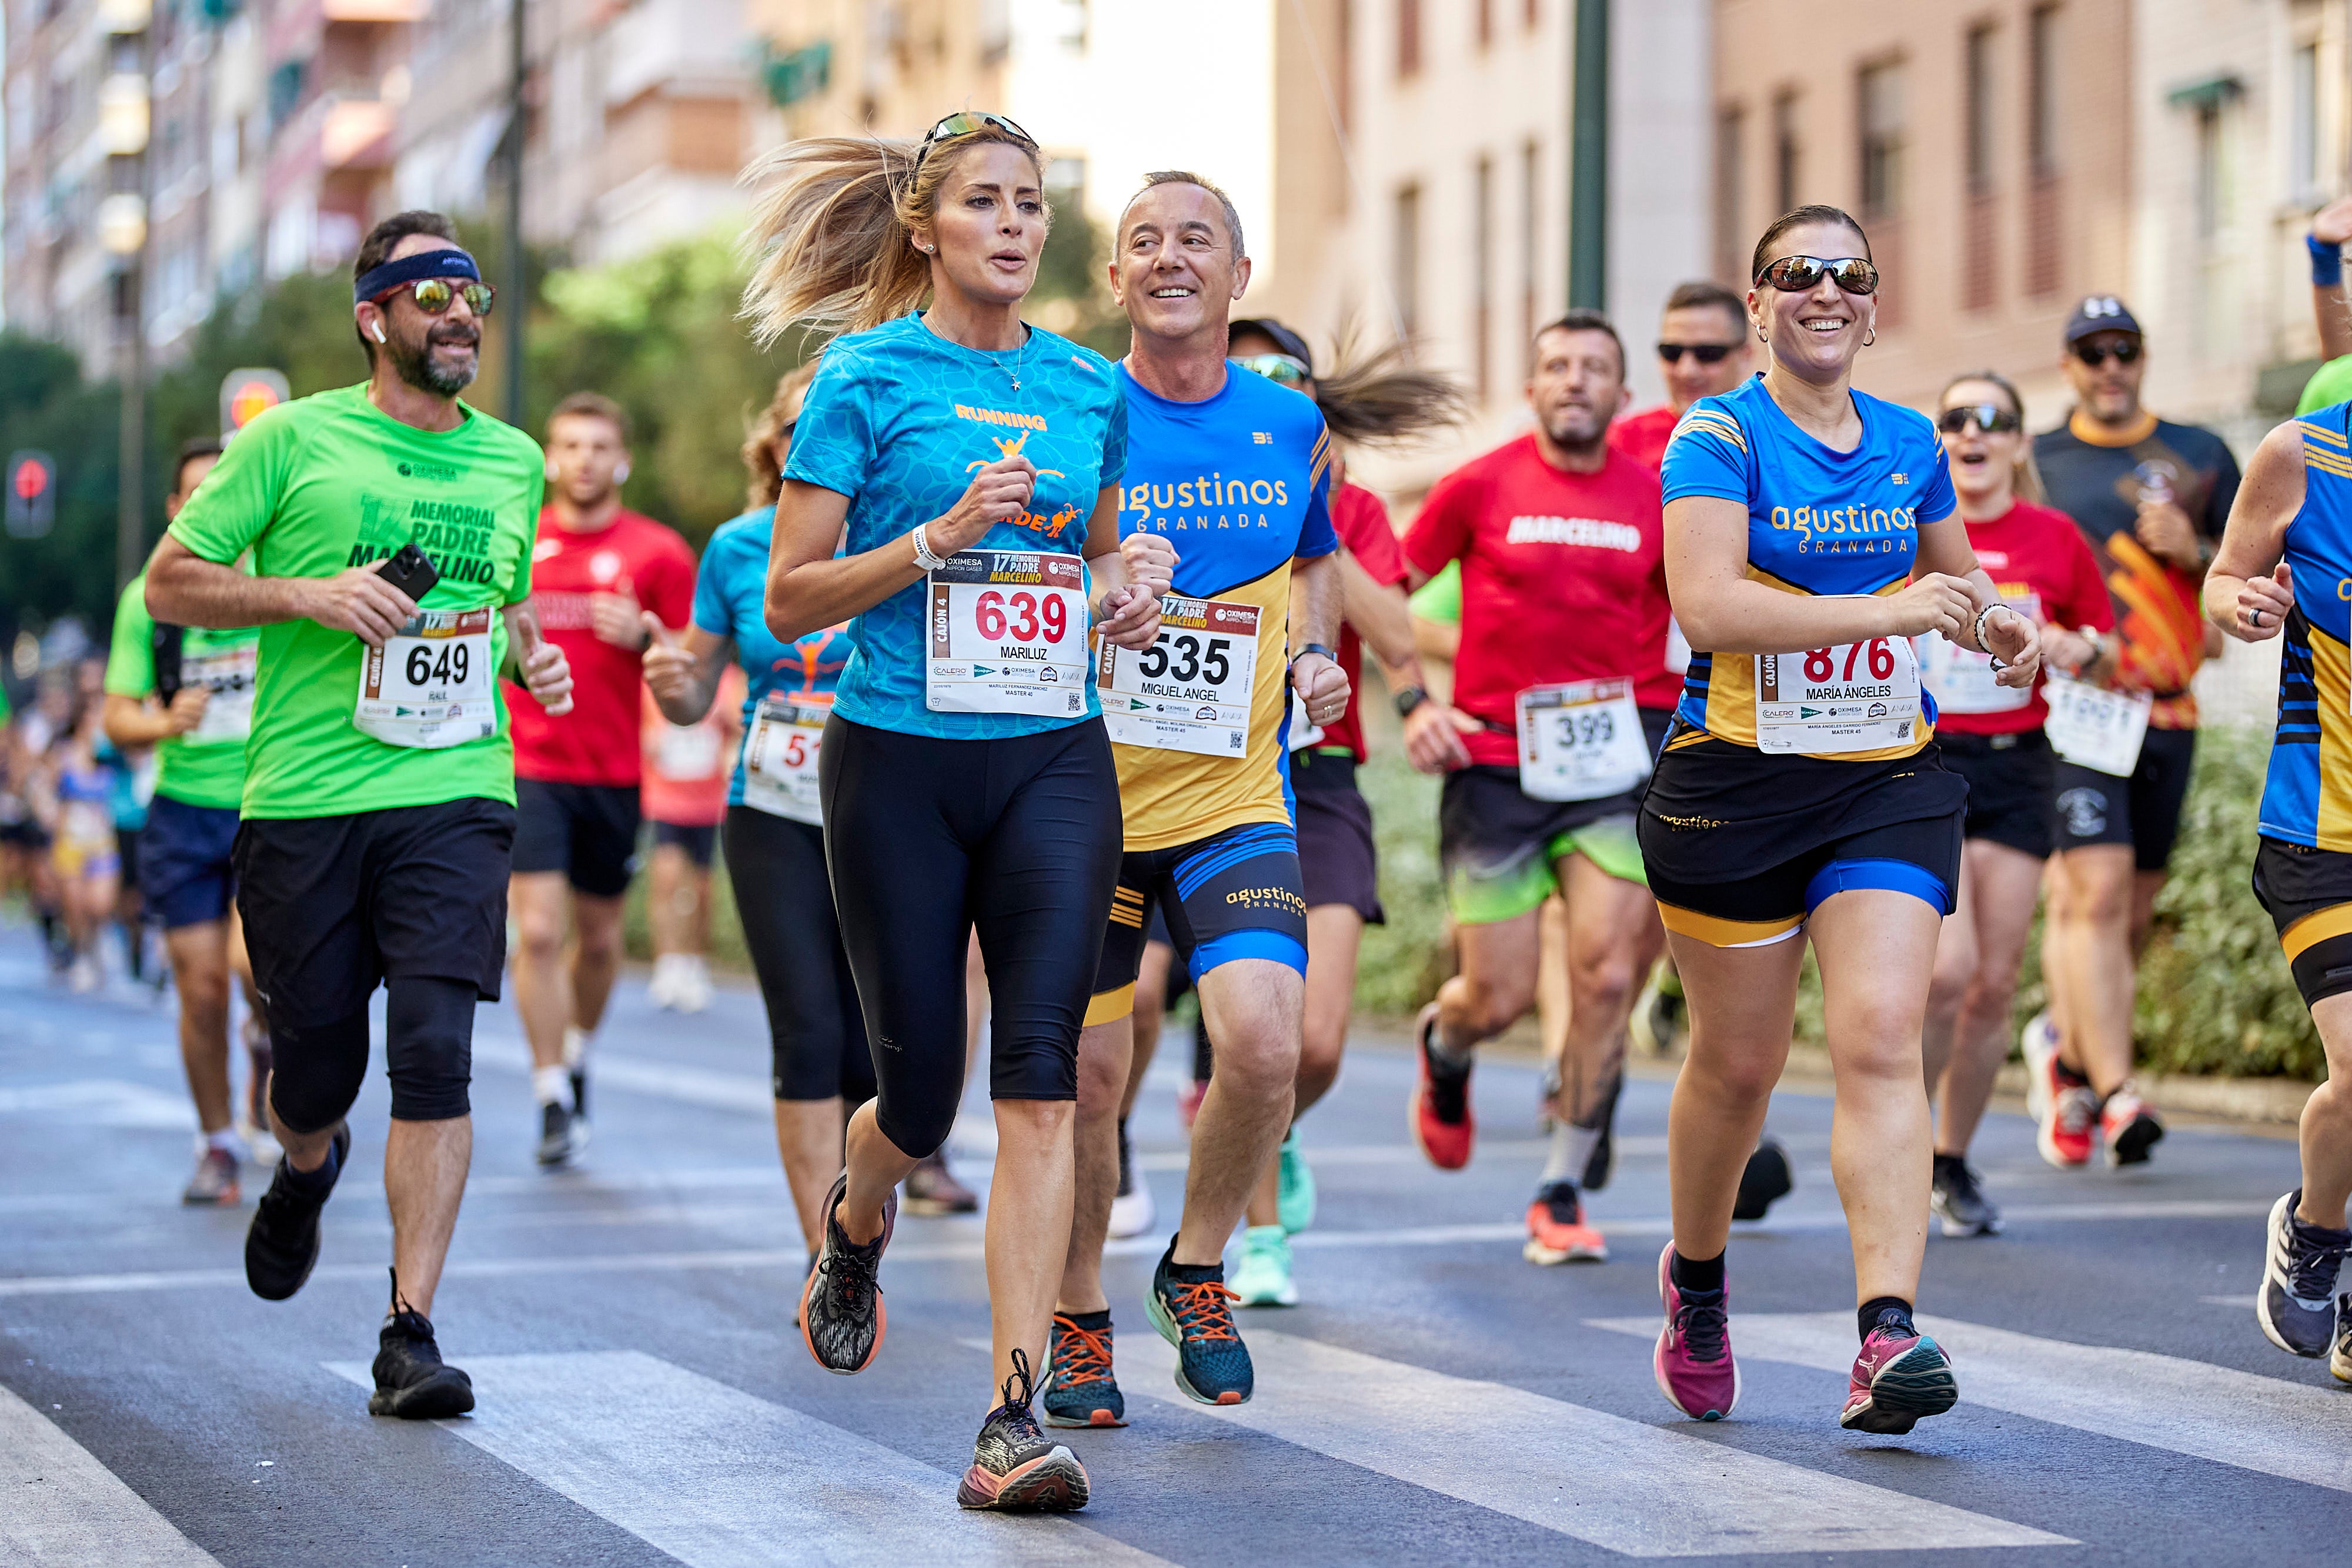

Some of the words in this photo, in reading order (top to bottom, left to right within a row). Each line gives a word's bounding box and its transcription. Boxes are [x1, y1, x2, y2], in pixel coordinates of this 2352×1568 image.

[954, 403, 1047, 432] RUNNING
[410, 500, 496, 529] MEMORIAL
[1137, 513, 1268, 532] GRANADA
[1771, 503, 1916, 540] agustinos
[412, 522, 491, 556] PADRE
[1799, 539, 1907, 553] GRANADA
[347, 544, 495, 583] MAELINO
[994, 554, 1011, 572] 17
[1010, 554, 1040, 563] MEMORIAL
[1010, 562, 1038, 573] PADRE
[989, 571, 1041, 583] MARCELINO
[1059, 563, 1080, 573] OXIMESA
[1160, 597, 1178, 615] 17
[1177, 607, 1205, 618] PADRE
[1178, 600, 1208, 610] MEMORIAL
[935, 609, 947, 643] CAJÓN
[941, 599, 947, 607] 4
[975, 591, 1067, 644] 639
[1001, 646, 1047, 660] MARILUZ
[1102, 643, 1115, 674] CAJÓN
[1139, 633, 1230, 685] 535
[1803, 637, 1895, 683] 876
[406, 643, 468, 686] 649
[1762, 654, 1775, 687] CAJÓN
[1061, 672, 1081, 681] ANAYA
[1141, 683, 1182, 698] MIGUEL
[1183, 688, 1219, 701] ANGEL
[1806, 685, 1842, 700] MARÍA
[1843, 683, 1891, 698] ÁNGELES
[1891, 704, 1913, 713] ANAYA
[1558, 710, 1613, 747] 399
[784, 734, 820, 768] 5
[1244, 901, 1302, 917] GRANADA
